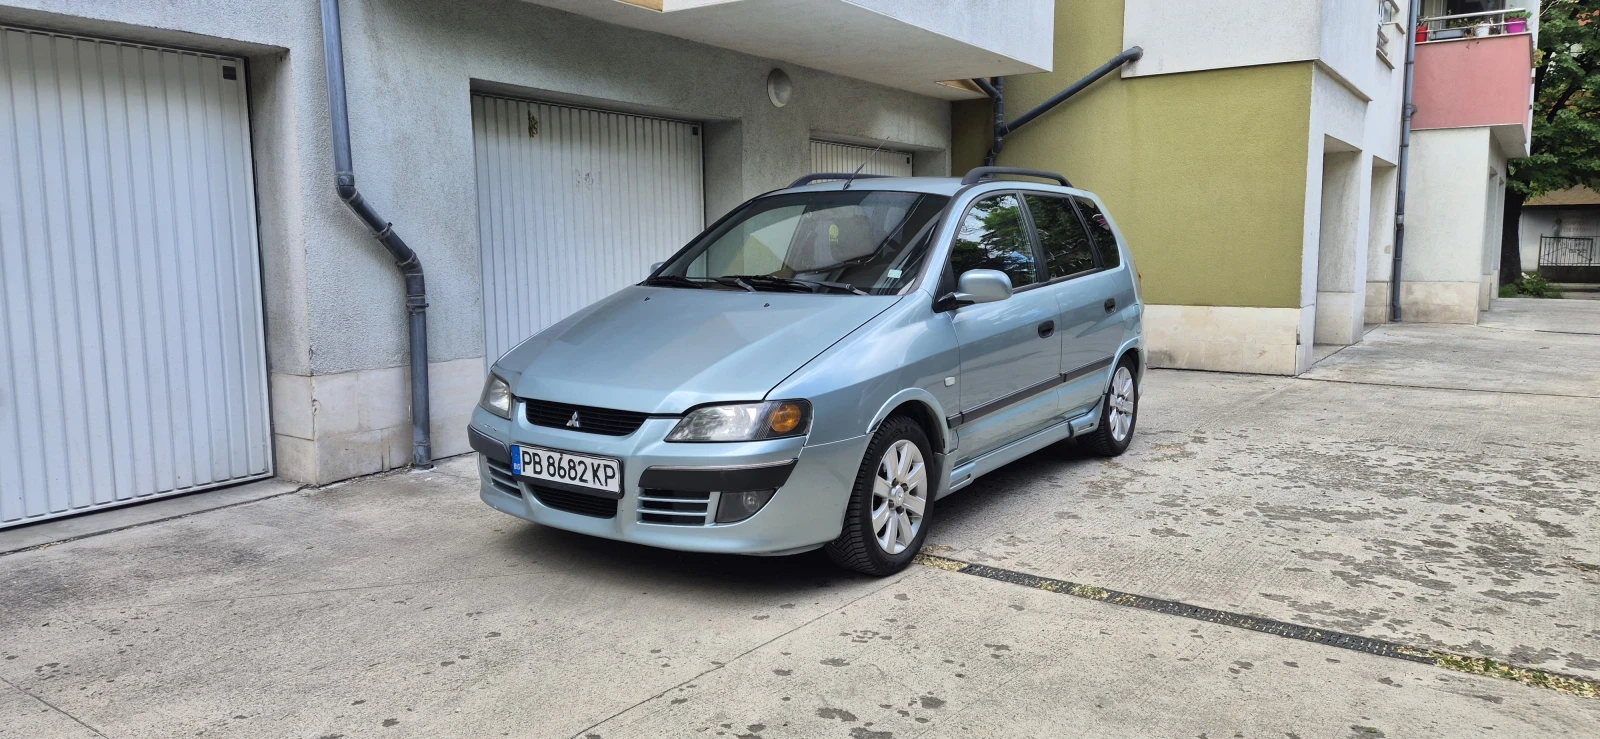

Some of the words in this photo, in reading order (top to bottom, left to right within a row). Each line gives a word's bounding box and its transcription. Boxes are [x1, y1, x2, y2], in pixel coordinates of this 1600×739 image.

[522, 451, 542, 475] PB
[547, 455, 588, 483] 8682
[591, 462, 615, 486] KP
